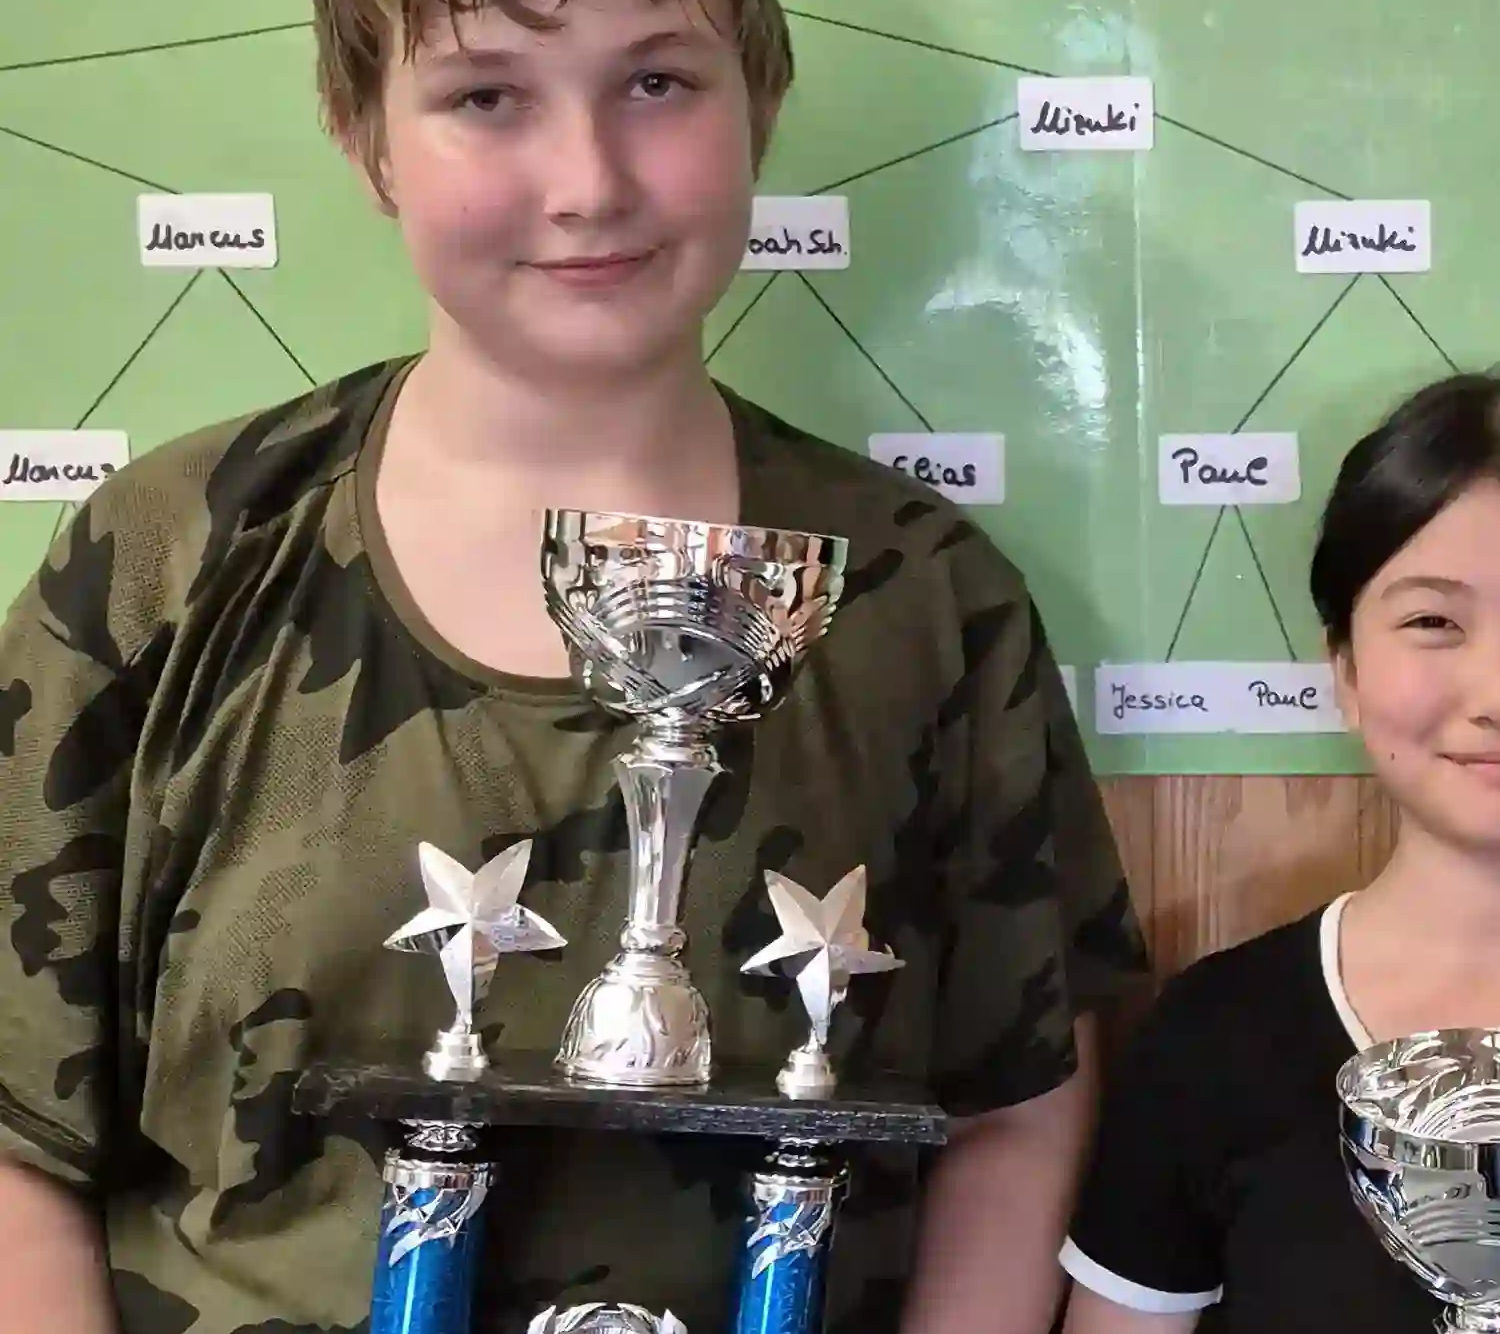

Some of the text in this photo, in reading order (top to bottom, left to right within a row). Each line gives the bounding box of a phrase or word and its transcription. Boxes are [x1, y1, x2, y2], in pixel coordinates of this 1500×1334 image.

[1030, 101, 1140, 136] Mizuki
[145, 223, 265, 251] Marcus
[748, 227, 801, 255] oah
[1302, 223, 1417, 257] Mizuki
[1172, 447, 1268, 486] Paul
[1111, 682, 1209, 720] Jessica
[1248, 680, 1319, 710] Paul
